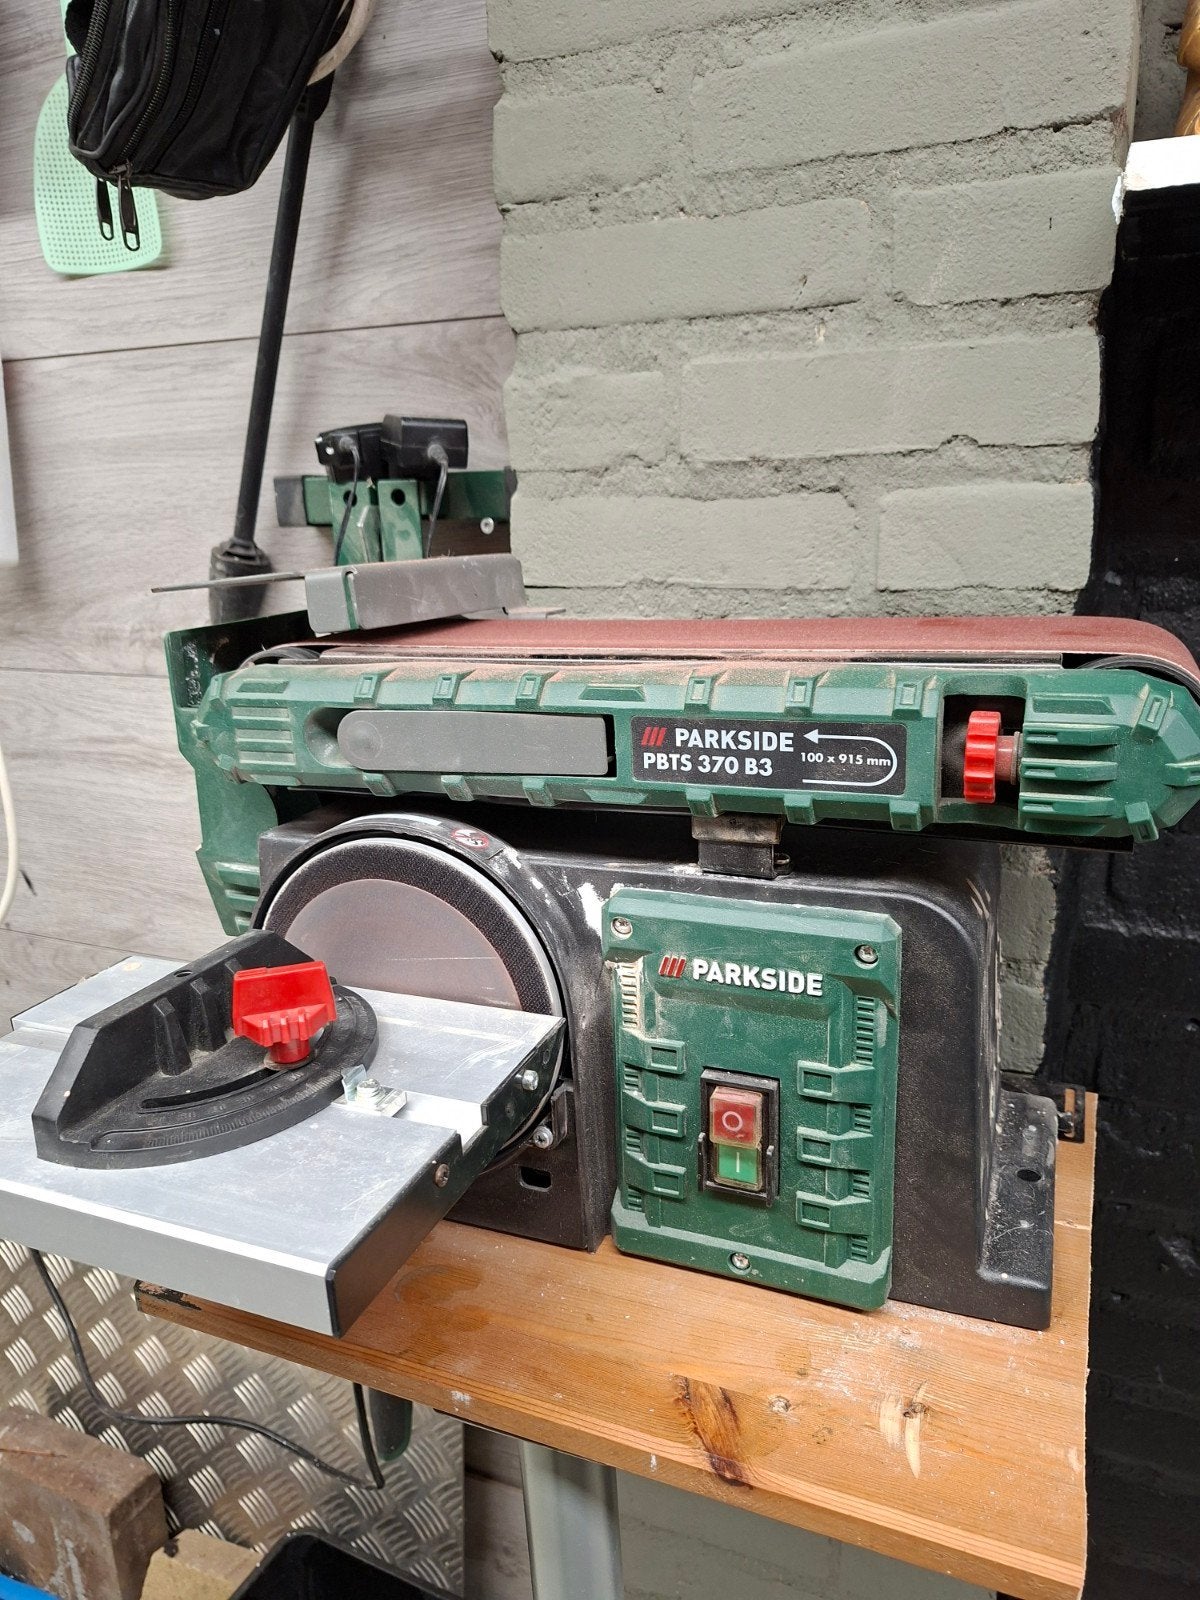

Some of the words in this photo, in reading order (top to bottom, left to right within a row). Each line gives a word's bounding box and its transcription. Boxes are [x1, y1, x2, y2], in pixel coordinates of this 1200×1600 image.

[675, 727, 794, 753] PARKSIDE
[643, 752, 692, 772] PBTS
[697, 754, 739, 775] 370
[745, 757, 773, 776] B3
[800, 752, 824, 763] 100
[838, 753, 863, 765] 915
[866, 757, 891, 767] mm
[692, 958, 823, 997] PARKSIDE
